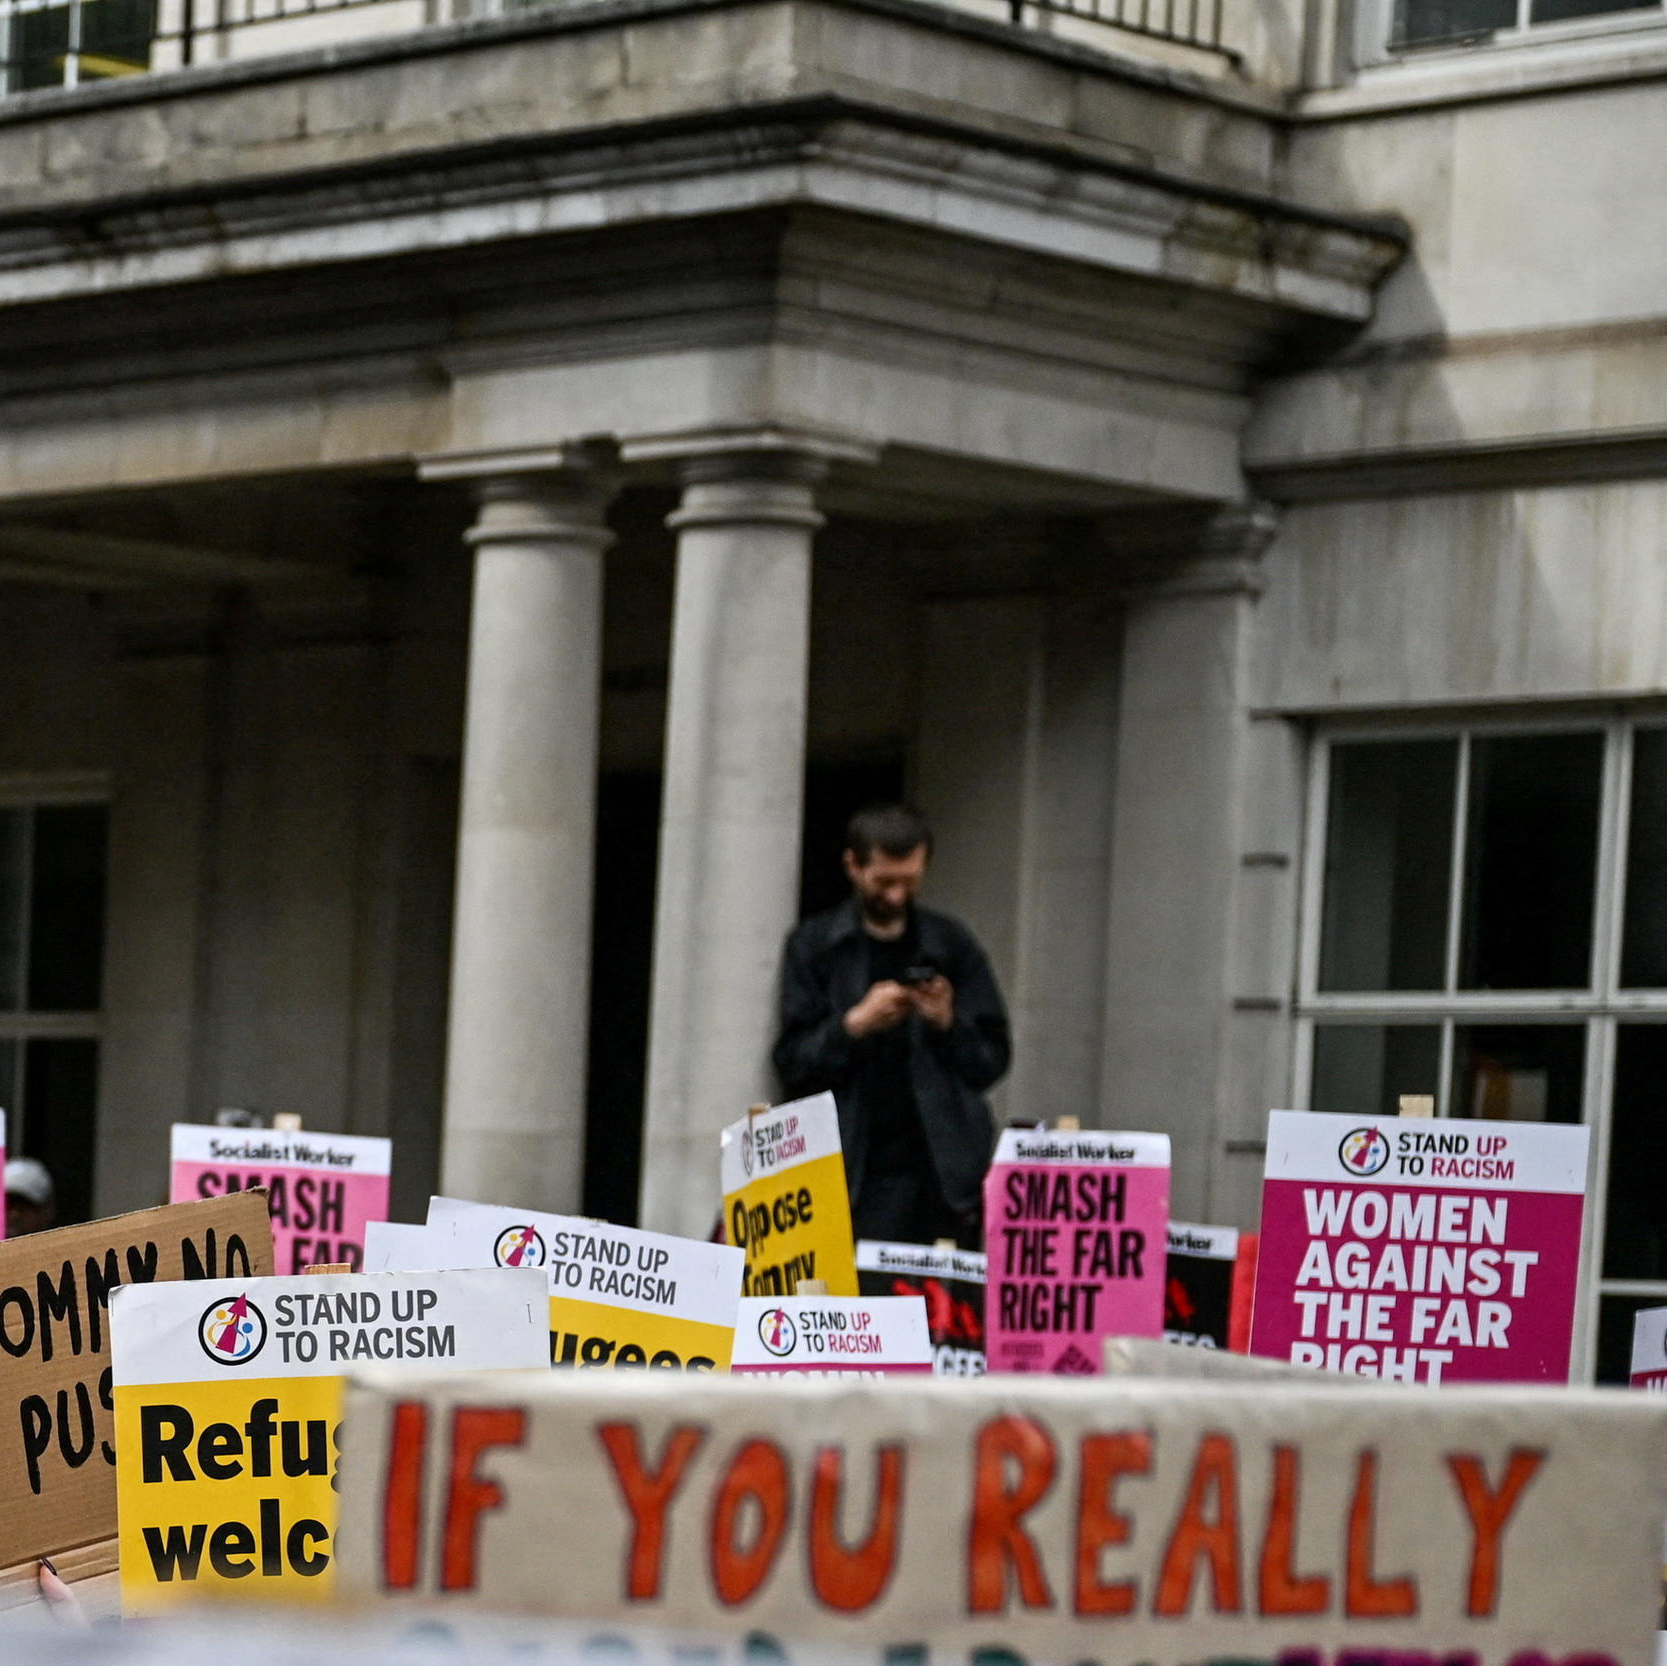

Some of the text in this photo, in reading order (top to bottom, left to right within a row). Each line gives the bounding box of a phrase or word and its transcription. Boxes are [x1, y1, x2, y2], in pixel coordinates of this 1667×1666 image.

[209, 1139, 356, 1167] Socialist Worker
[757, 1149, 775, 1168] TO
[1397, 1132, 1507, 1158] STAND UP
[1397, 1154, 1515, 1181] TO RACISM
[1004, 1170, 1127, 1223] SMASH
[1302, 1188, 1508, 1246] WOMEN
[732, 1186, 813, 1259] Oppose
[553, 1231, 670, 1272] STAND UP
[1002, 1228, 1146, 1279] THE FAR
[1294, 1240, 1539, 1298] AGAINST
[551, 1260, 677, 1306] TO RACISM
[275, 1288, 438, 1326] STAND UP
[798, 1309, 872, 1331] STAND UP
[999, 1281, 1104, 1334] RIGHT
[1291, 1290, 1513, 1350] THE FAR
[276, 1324, 456, 1363] TO RACISM
[803, 1333, 883, 1354] TO RACISM
[382, 1401, 1547, 1619] IF YOU REALLY
